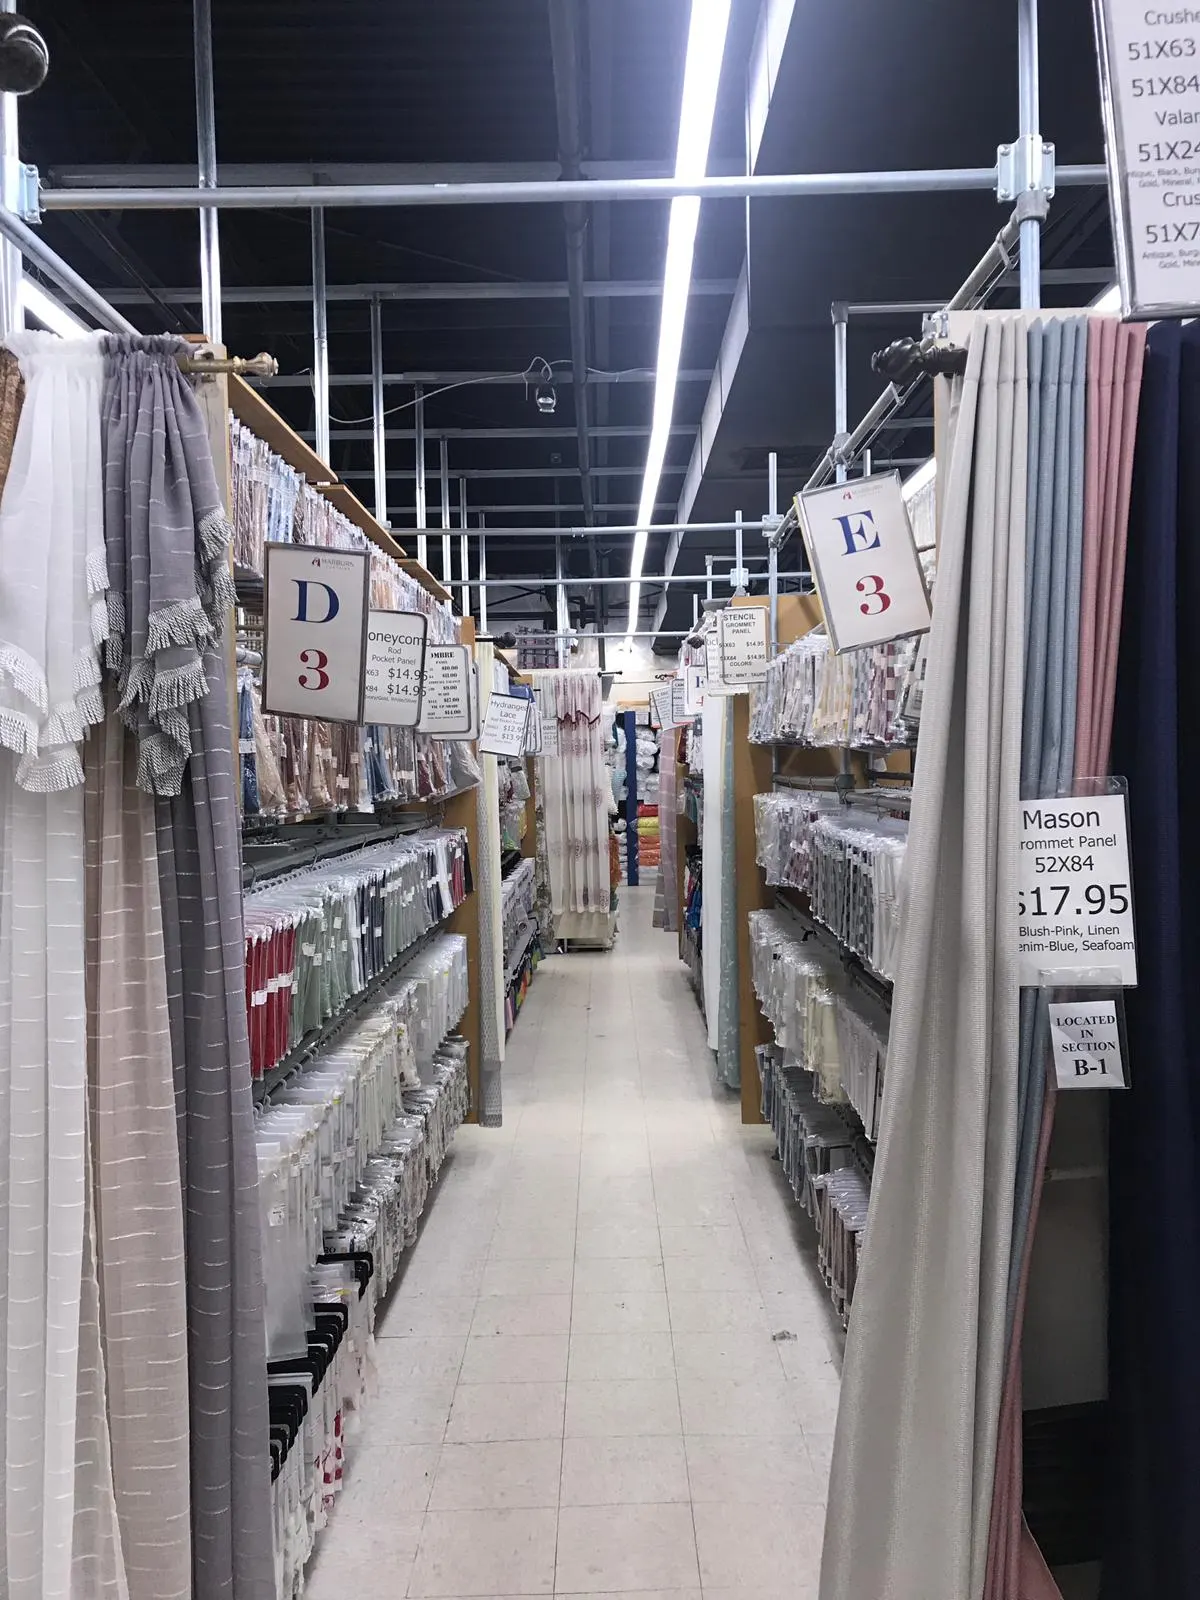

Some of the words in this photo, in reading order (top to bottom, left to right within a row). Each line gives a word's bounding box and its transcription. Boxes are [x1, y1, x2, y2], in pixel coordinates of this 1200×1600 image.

[1128, 39, 1196, 60] 51X63
[1132, 75, 1200, 97] 51X84
[832, 510, 881, 557] E
[290, 579, 340, 624] D
[856, 575, 891, 616] 3
[723, 613, 756, 621] STENCIL
[387, 646, 402, 654] Rod
[371, 654, 395, 663] Pocket
[397, 656, 416, 665] Panel
[298, 649, 330, 691] 3
[388, 667, 428, 681] $14.95
[387, 683, 427, 697] $14.95
[500, 711, 517, 719] Lace
[1023, 810, 1100, 830] Mason
[1079, 834, 1117, 848] Panel
[1035, 855, 1094, 873] 52X84
[1019, 925, 1083, 938] Blush-Pink,
[1088, 925, 1120, 936] Linen
[1082, 940, 1135, 951] Seafoam
[1056, 1015, 1115, 1026] LOCATED
[1080, 1029, 1094, 1038] IN
[1062, 1041, 1116, 1052] SECTION
[1072, 1058, 1108, 1075] B-1
